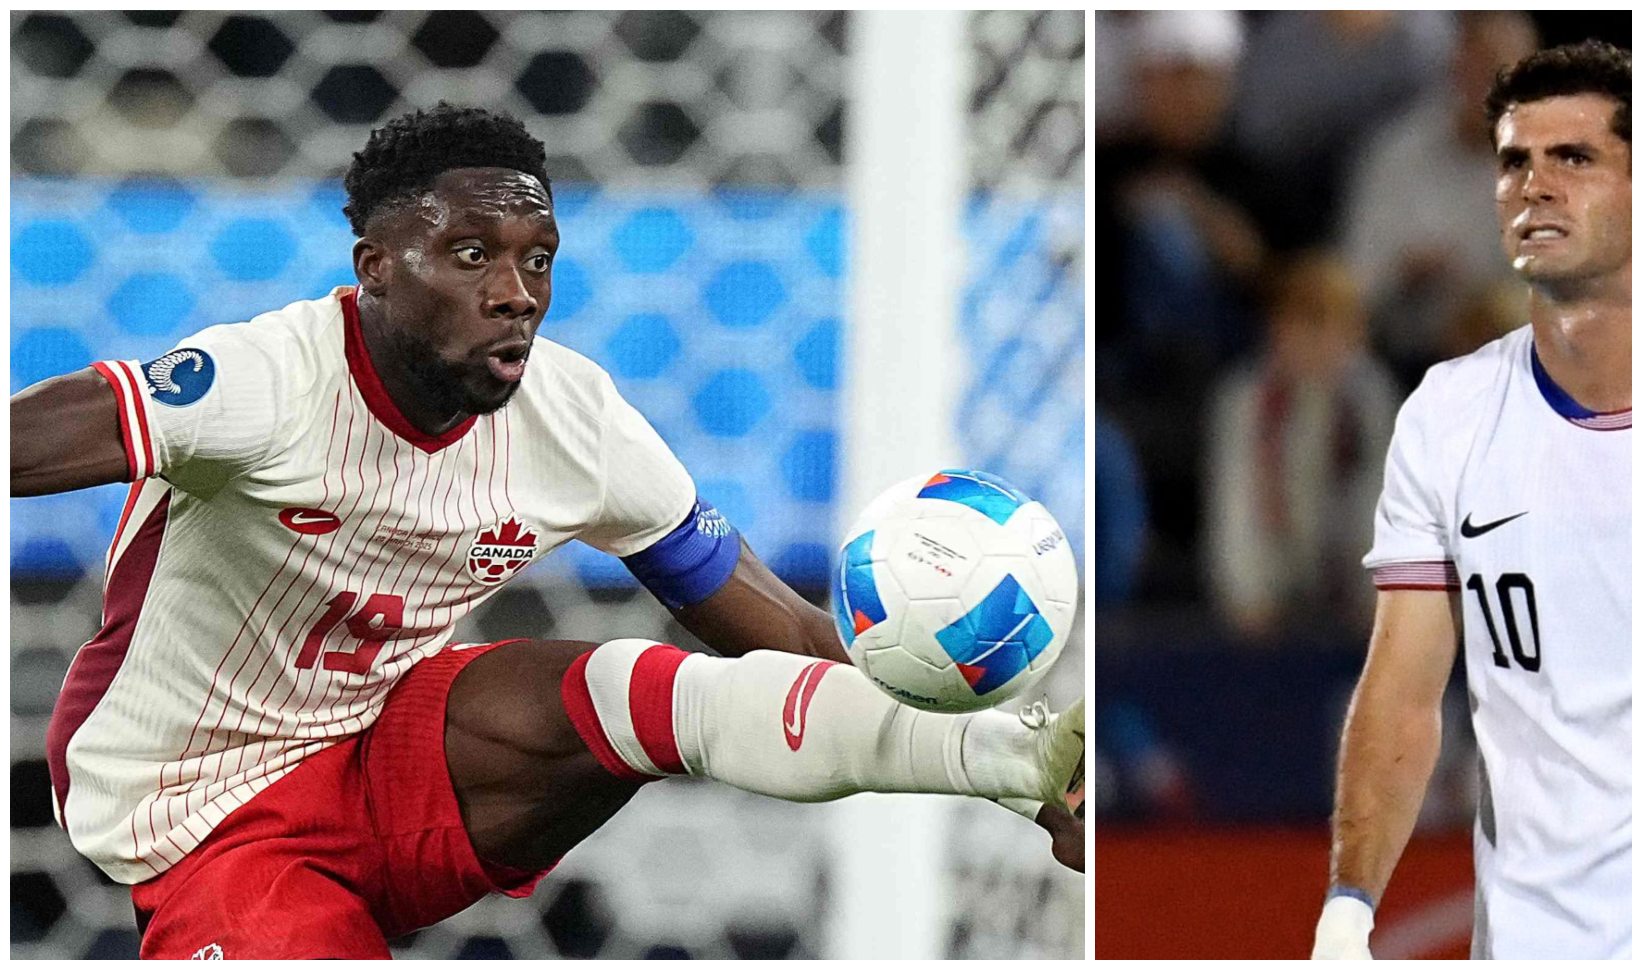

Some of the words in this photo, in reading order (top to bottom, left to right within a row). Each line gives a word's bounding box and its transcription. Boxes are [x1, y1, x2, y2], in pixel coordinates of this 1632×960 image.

[470, 546, 534, 559] CANADA
[294, 591, 403, 676] 19
[1466, 572, 1541, 673] 10
